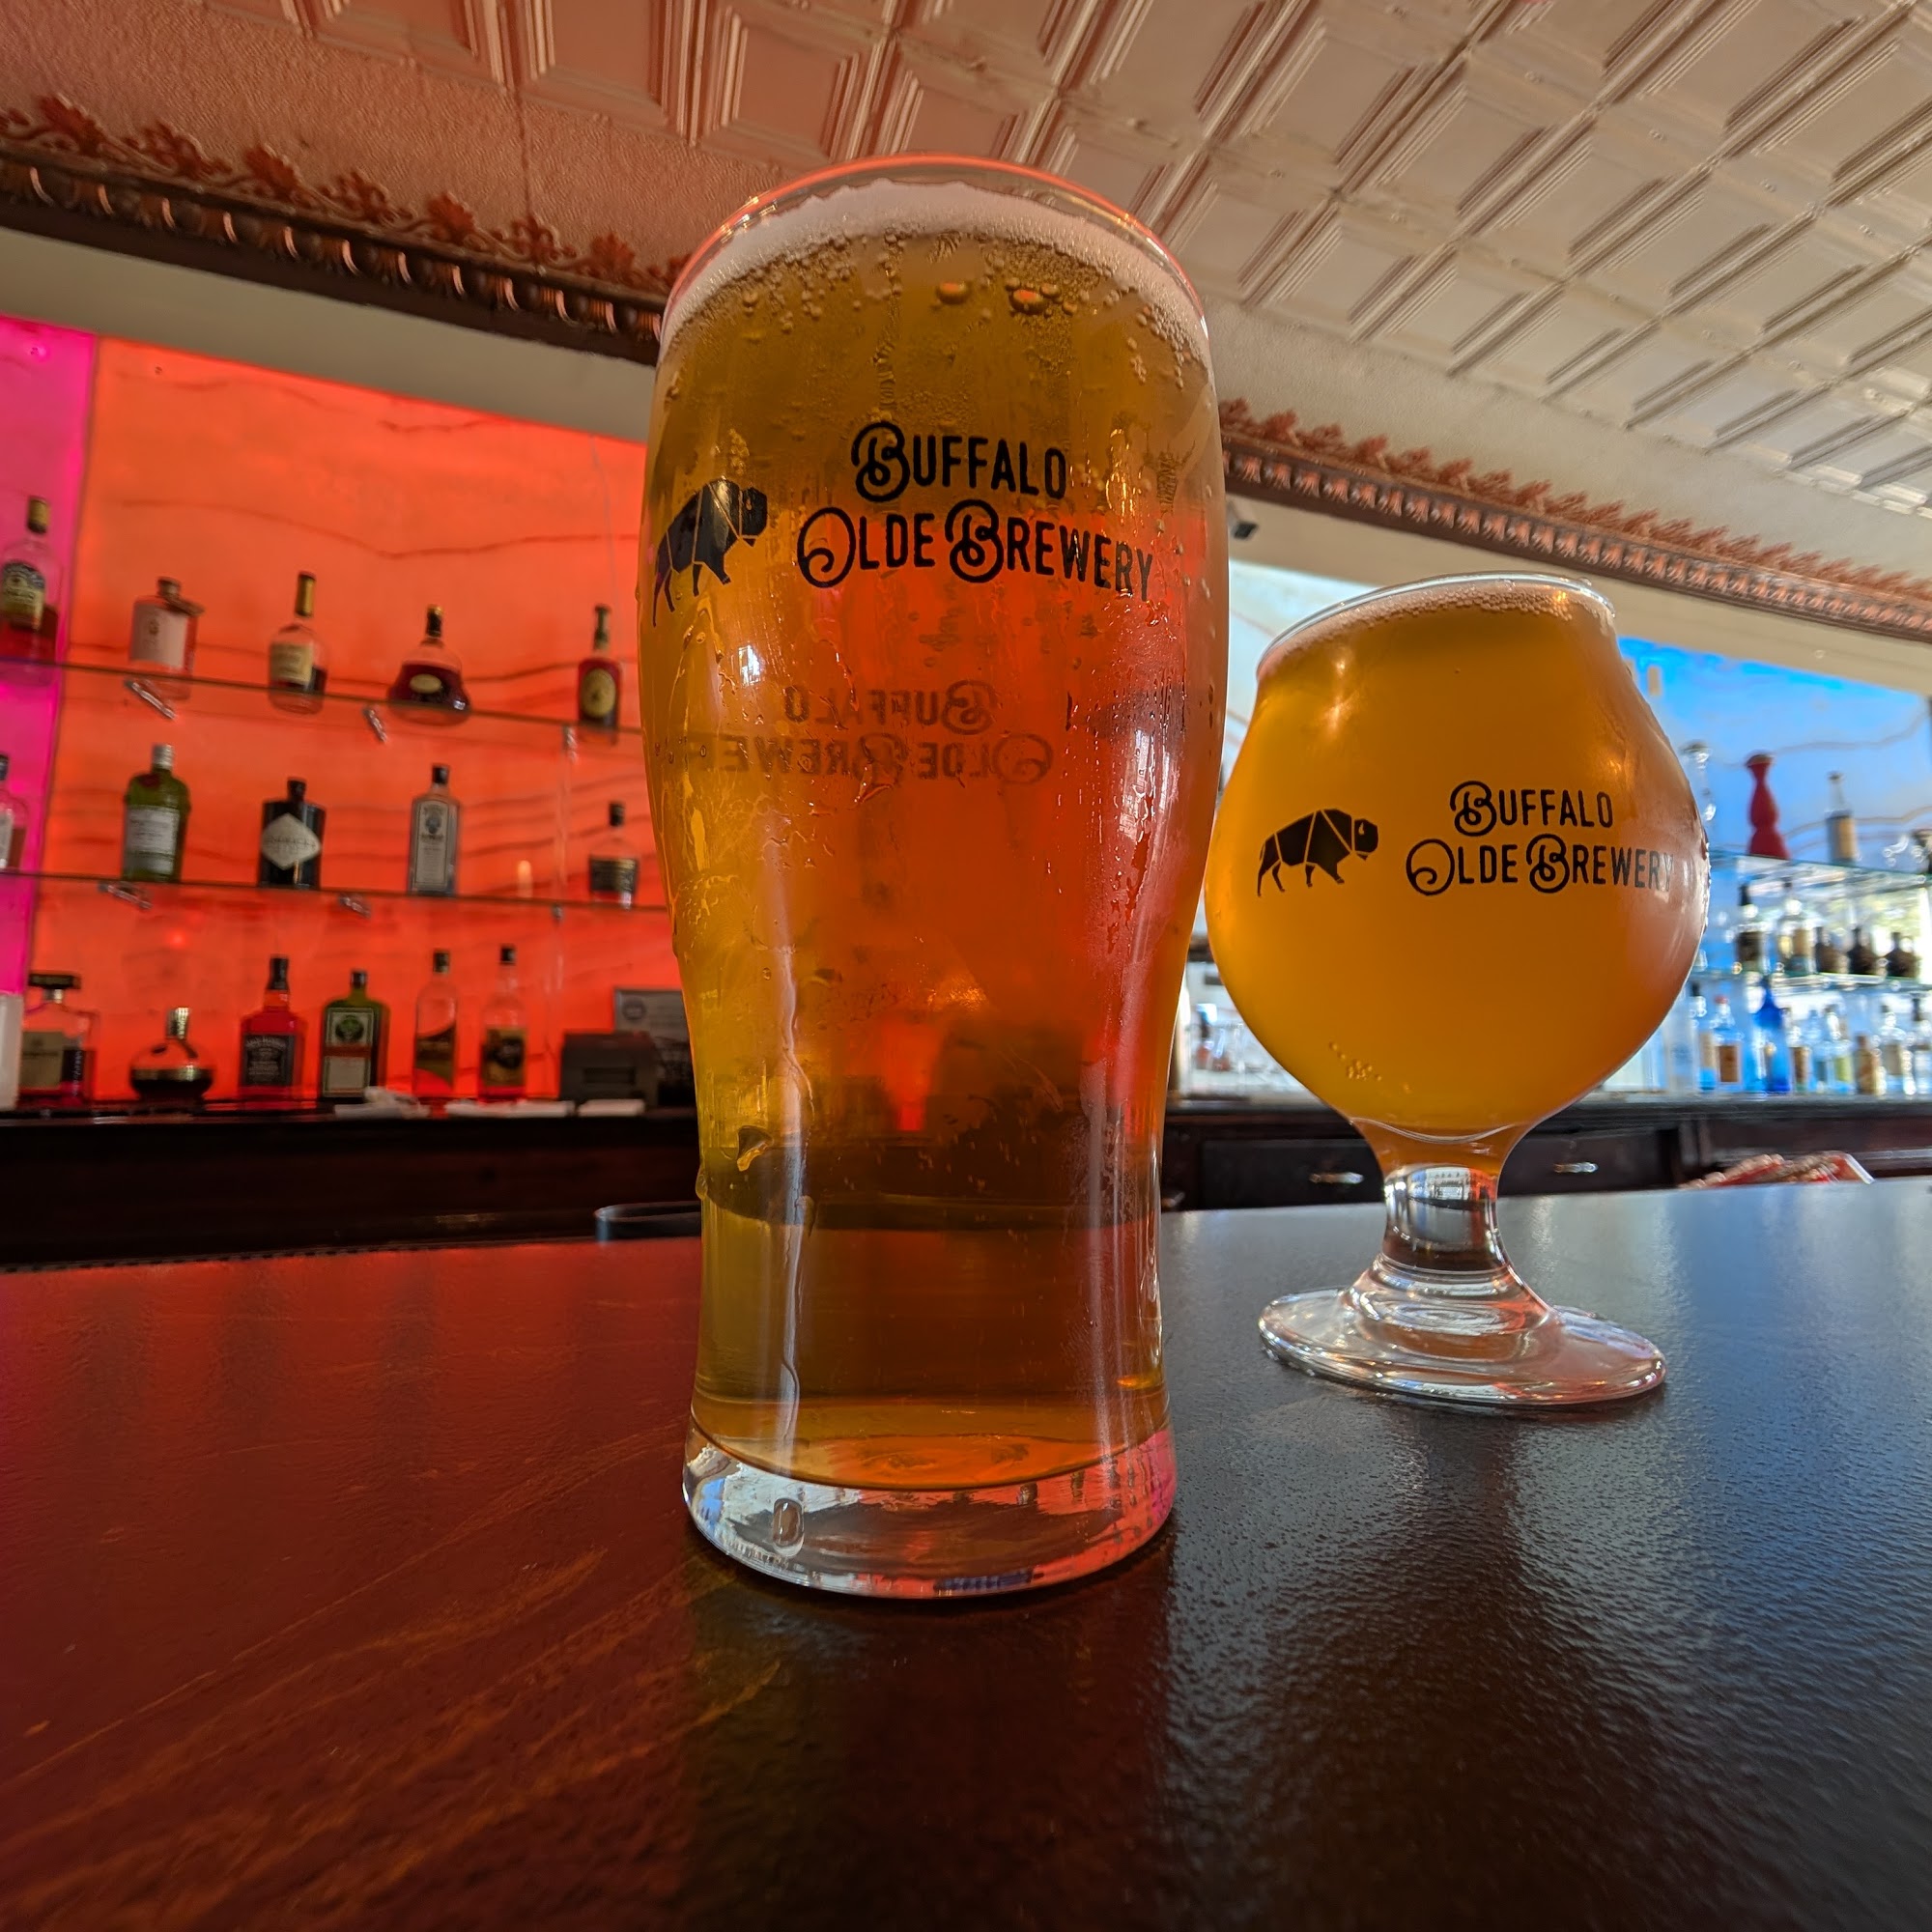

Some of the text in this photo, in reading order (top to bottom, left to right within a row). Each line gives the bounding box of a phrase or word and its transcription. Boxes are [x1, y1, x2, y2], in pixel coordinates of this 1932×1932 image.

[851, 420, 1067, 502] BUFFALO
[796, 499, 1153, 602] OLDE BREWERY
[1449, 780, 1613, 838] BUFFALO
[1405, 833, 1674, 896] OLDE BREWERY
